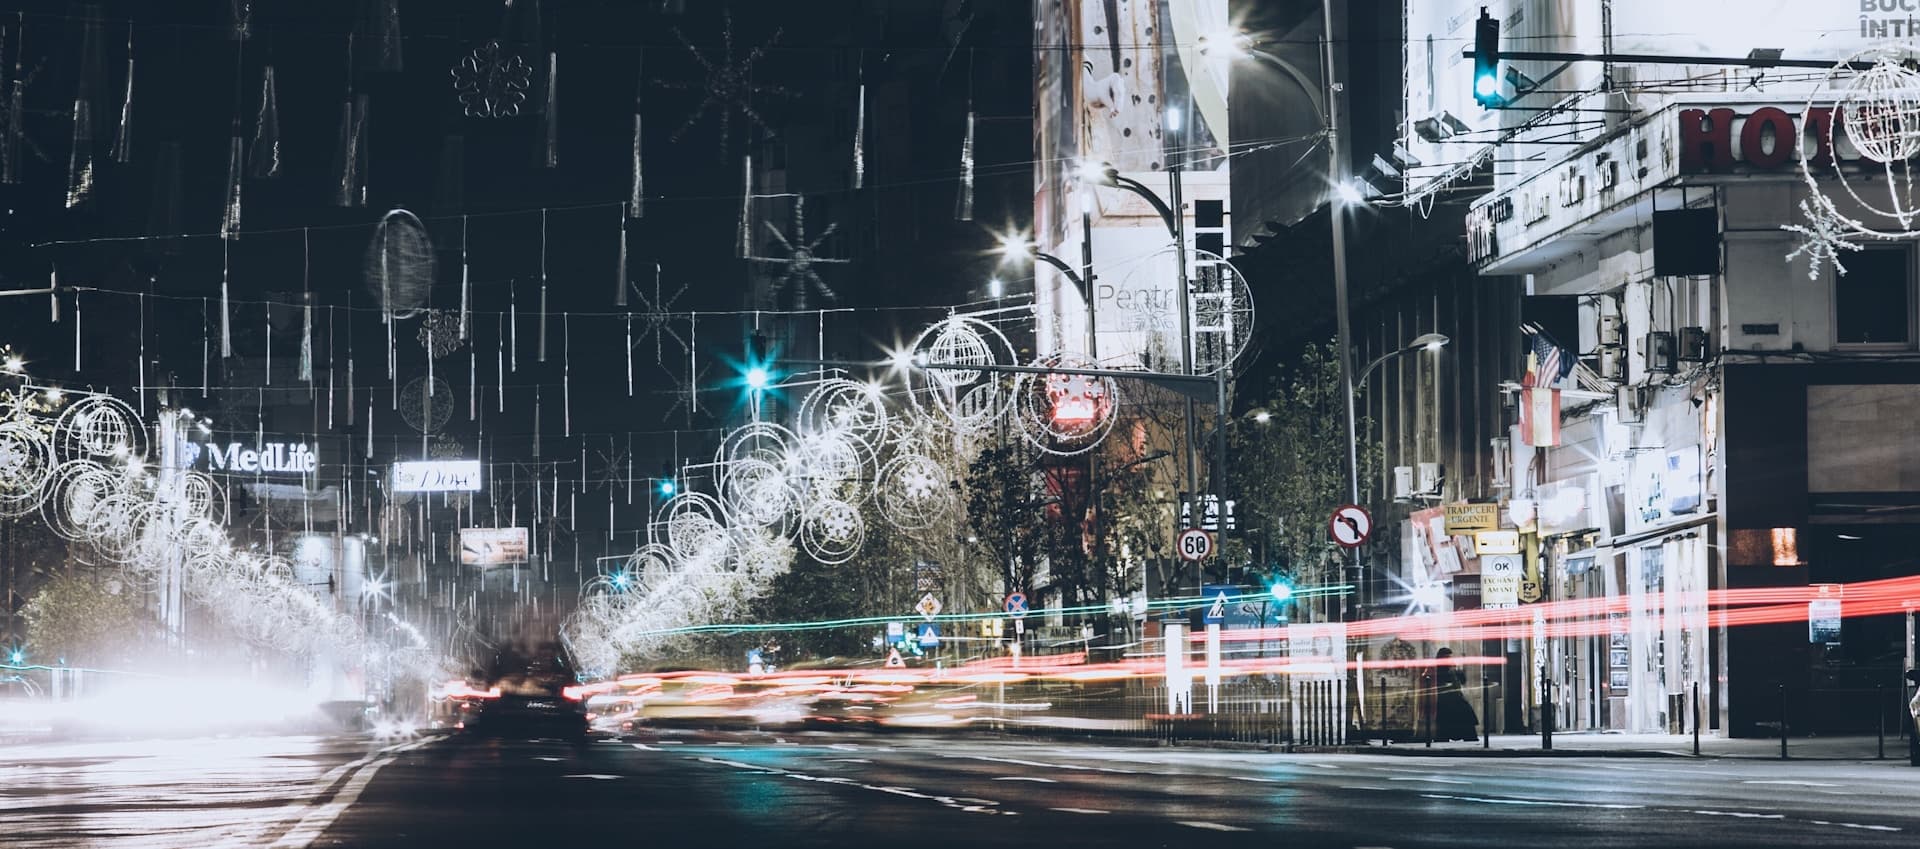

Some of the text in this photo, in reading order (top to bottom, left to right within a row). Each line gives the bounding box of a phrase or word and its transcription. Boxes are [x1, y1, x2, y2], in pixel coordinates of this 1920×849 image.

[1861, 0, 1920, 12] BUC
[1098, 285, 1180, 309] Pentr
[206, 442, 315, 471] MedLife
[1447, 505, 1495, 514] TRADUCERI
[1185, 536, 1206, 554] 60
[1495, 562, 1510, 571] OK
